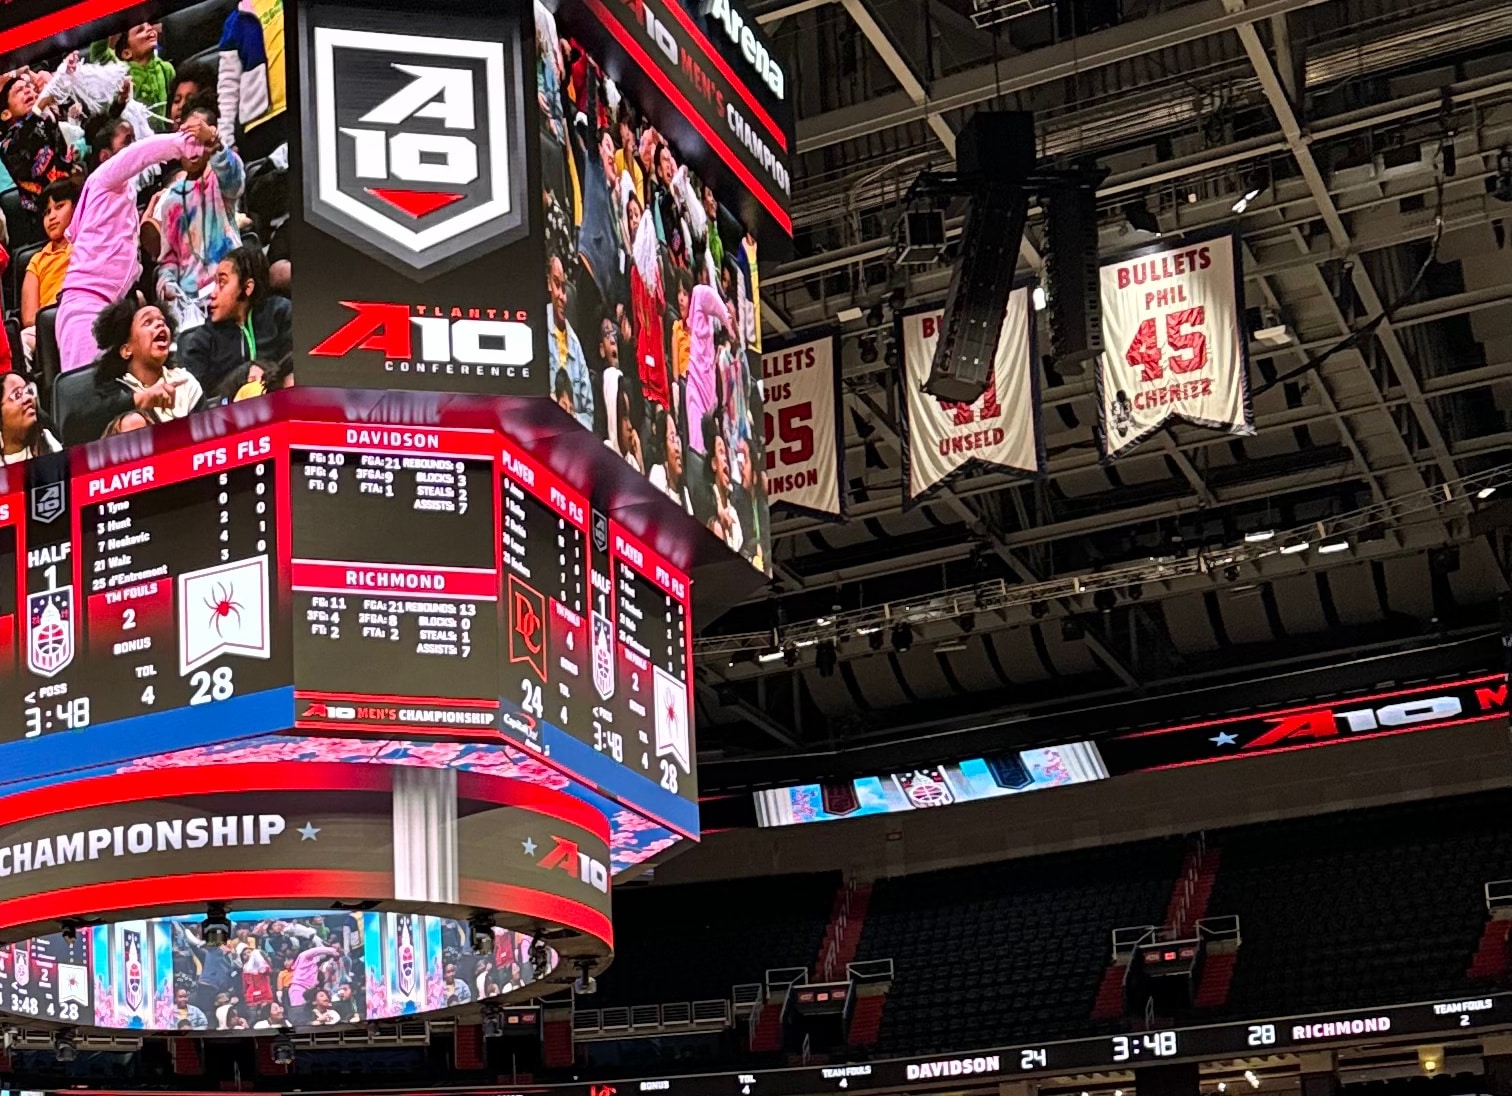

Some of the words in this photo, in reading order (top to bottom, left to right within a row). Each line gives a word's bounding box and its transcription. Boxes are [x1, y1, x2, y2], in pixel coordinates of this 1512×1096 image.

[712, 0, 784, 99] Arena
[681, 48, 725, 118] MEN'S
[1117, 246, 1211, 289] BULLETS
[1145, 284, 1187, 310] PHIL
[1125, 306, 1207, 382] 45
[385, 361, 530, 377] CONFERENCE
[346, 429, 438, 449] DAVIDSON
[939, 427, 1005, 456] UNSELD
[89, 466, 154, 497] PLAYER
[193, 448, 227, 470] PTS
[238, 436, 271, 460] FLS
[327, 453, 344, 466] 10
[384, 457, 401, 470] 21
[455, 461, 465, 473] 9
[107, 500, 129, 514] Tyne
[97, 523, 105, 534] 3
[108, 517, 132, 533] Hunt
[27, 541, 71, 568] HALF
[98, 541, 105, 552] 7
[44, 565, 57, 590] 1
[94, 560, 105, 572] 21
[93, 577, 106, 590] 25
[345, 570, 445, 590] RICHMOND
[105, 592, 122, 604] TM
[123, 582, 158, 602] FOULS
[122, 609, 137, 630] 2
[113, 636, 151, 655] BONUS
[461, 646, 471, 658] 7
[39, 683, 67, 698] POSS
[141, 685, 155, 705] 4
[190, 666, 234, 706] 28
[521, 678, 544, 719] 24
[24, 697, 90, 738] 3:48
[302, 702, 355, 719] A10
[357, 708, 397, 720] MEN'S
[398, 709, 495, 724] CHAMPIONSHIP
[1240, 696, 1461, 750] A10
[593, 721, 623, 763] 3:48
[660, 759, 678, 794] 28
[537, 835, 608, 893] A10
[1248, 1025, 1275, 1046] 28
[1293, 1017, 1391, 1040] RICHMOND
[907, 1056, 1000, 1080] DAVIDSON
[1021, 1049, 1046, 1069] 24
[1113, 1032, 1177, 1061] 3:48
